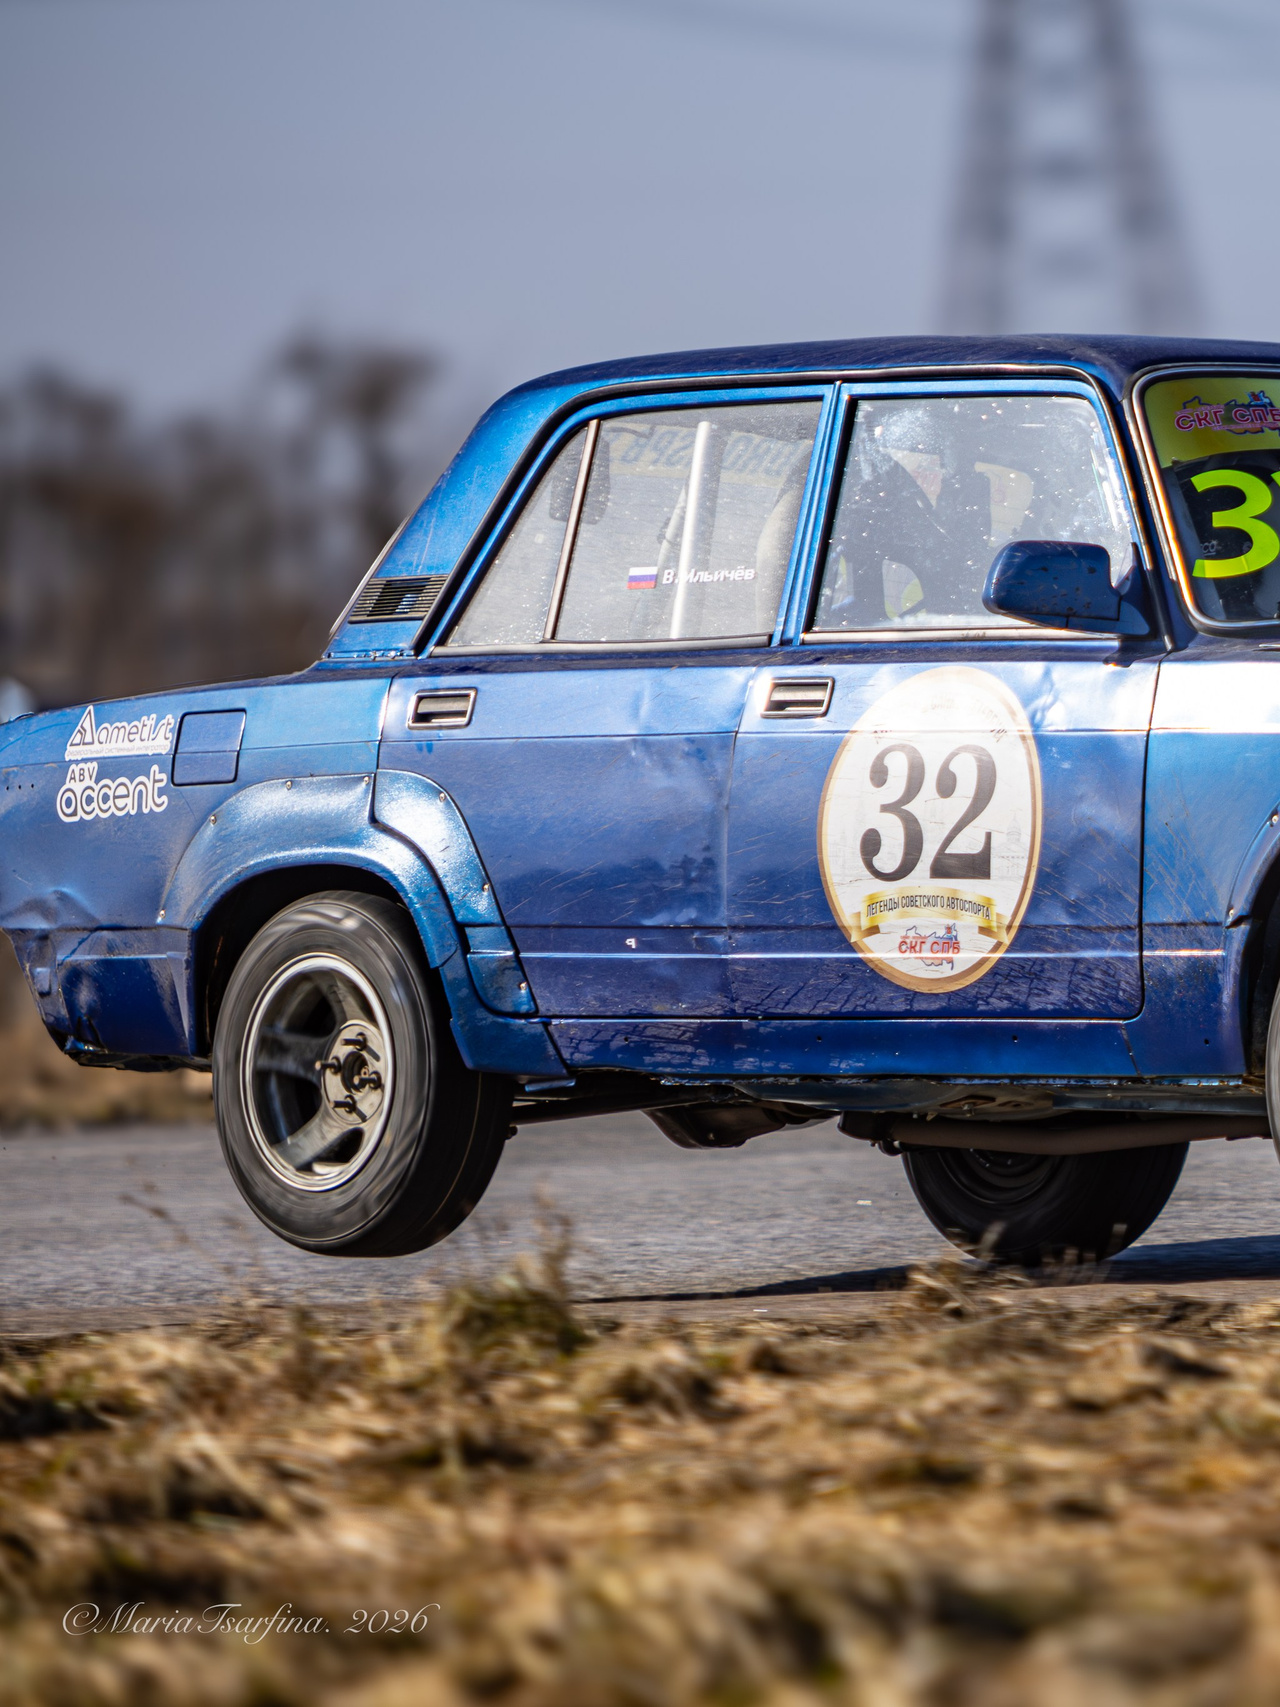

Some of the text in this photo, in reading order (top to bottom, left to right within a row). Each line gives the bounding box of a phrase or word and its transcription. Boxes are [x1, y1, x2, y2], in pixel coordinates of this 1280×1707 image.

[1174, 409, 1224, 431] СКГ
[68, 767, 96, 783] ABV
[59, 769, 167, 818] accent
[860, 744, 997, 881] 32
[866, 894, 992, 920] ЛЕГЕНДЫ СОВЕТСКОГО АВТОСПОРТА
[898, 940, 960, 955] СКГ СПБ
